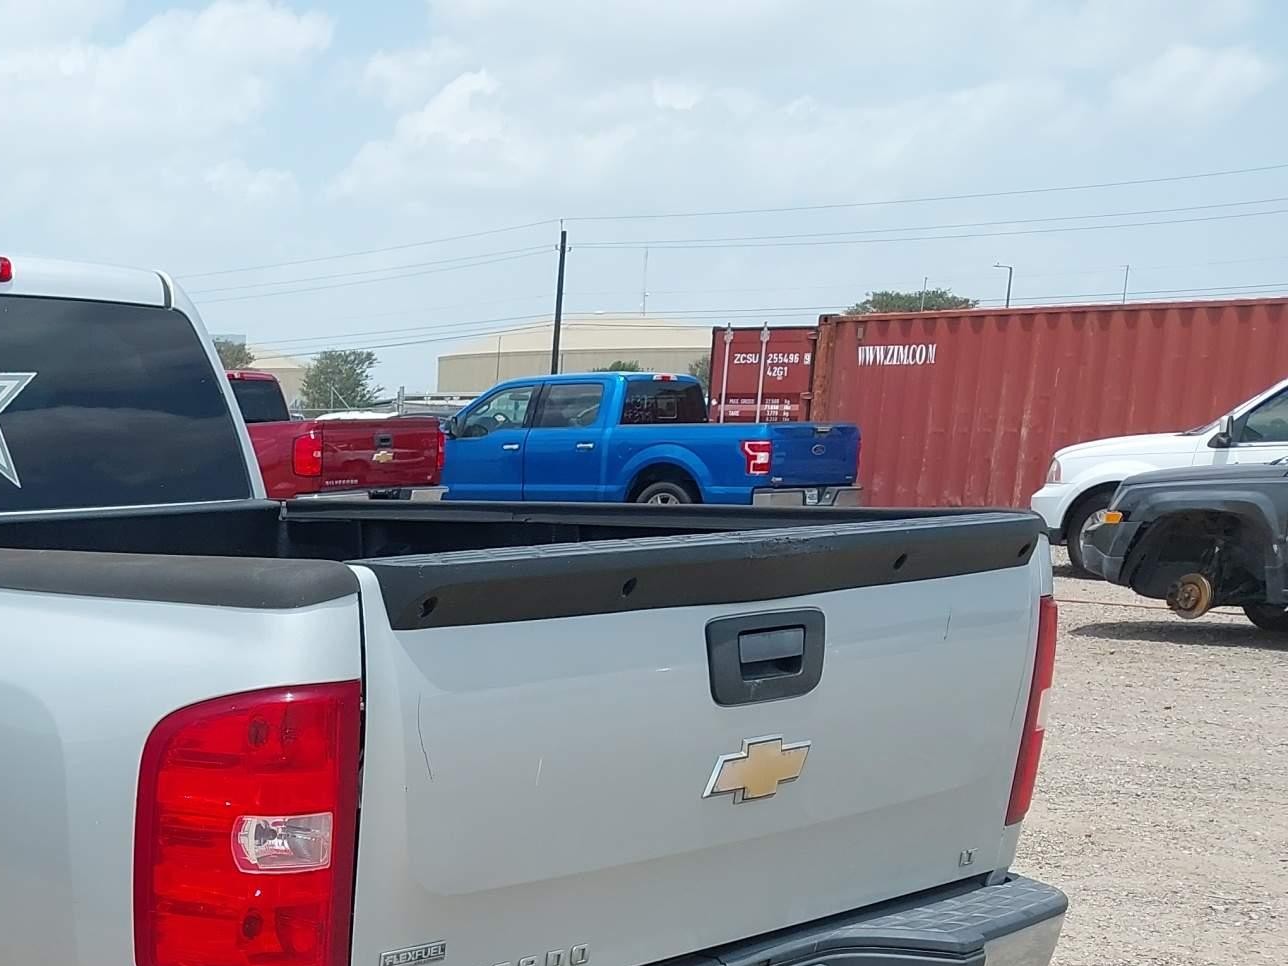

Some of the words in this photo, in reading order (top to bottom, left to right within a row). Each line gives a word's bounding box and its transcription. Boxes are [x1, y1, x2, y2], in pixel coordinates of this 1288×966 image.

[733, 353, 760, 364] ZCSU
[766, 353, 800, 364] 255496
[803, 353, 812, 365] 9
[766, 366, 788, 377] 42G1
[383, 945, 445, 966] FLEXFUEL
